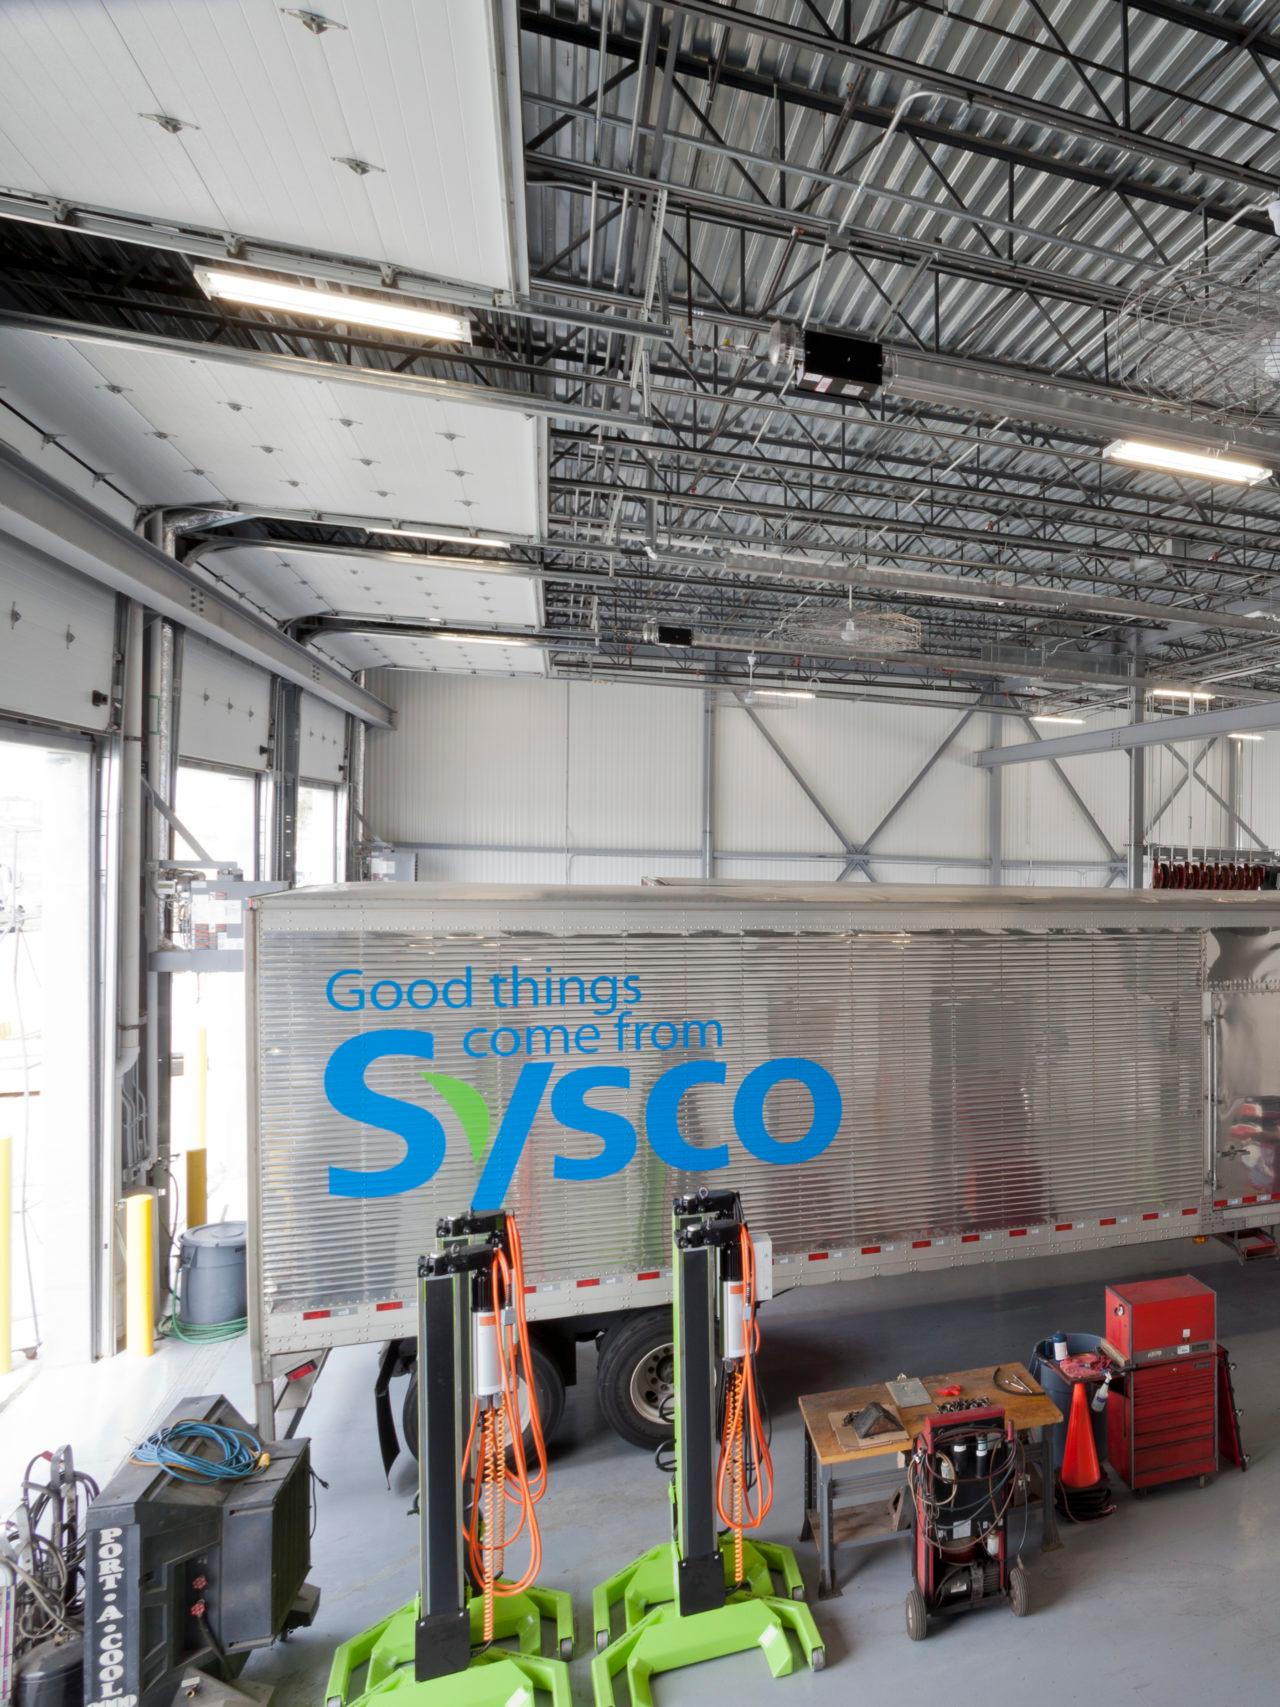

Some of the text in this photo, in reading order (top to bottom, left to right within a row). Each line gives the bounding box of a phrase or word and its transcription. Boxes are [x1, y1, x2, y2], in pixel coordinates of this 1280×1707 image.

[325, 965, 642, 1015] Good things
[463, 1011, 723, 1058] come from
